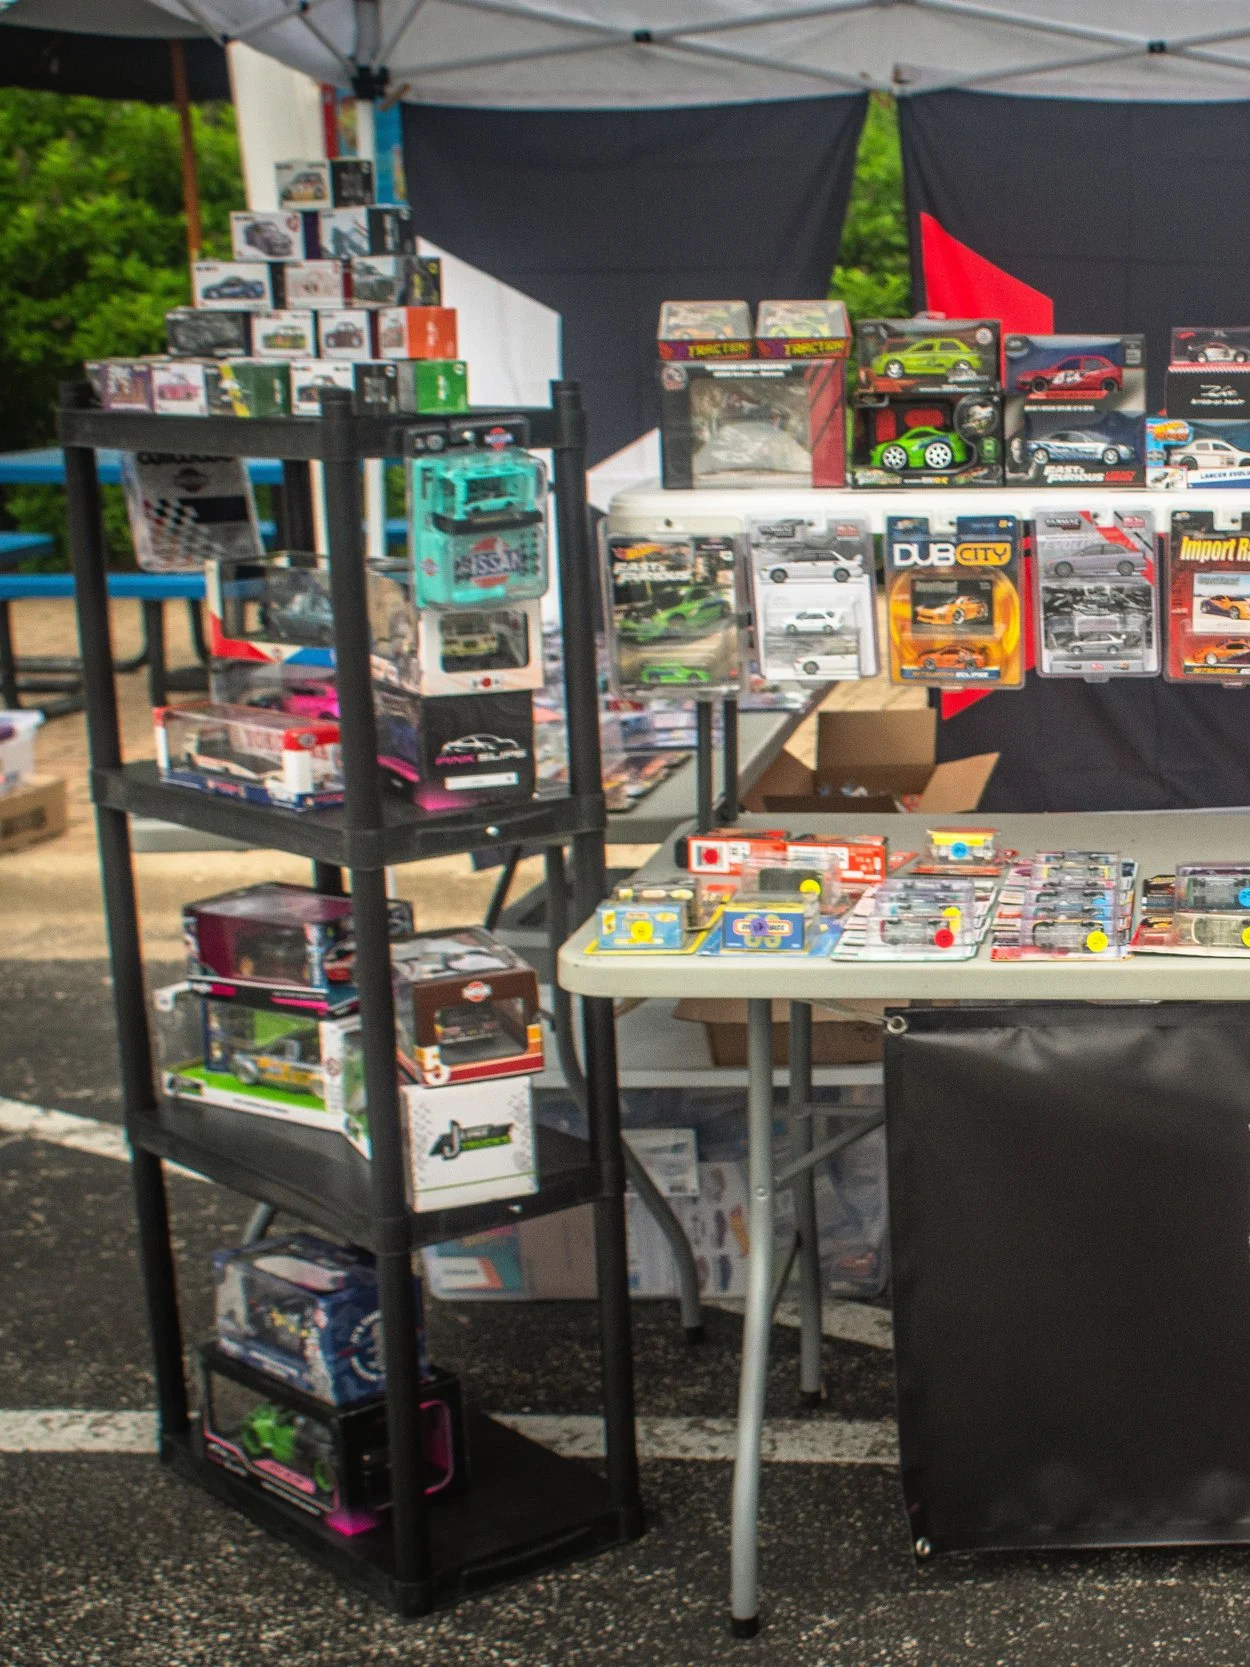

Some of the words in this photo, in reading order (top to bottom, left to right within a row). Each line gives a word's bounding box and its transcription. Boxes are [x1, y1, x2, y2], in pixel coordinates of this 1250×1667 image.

[892, 543, 956, 566] DUB
[959, 547, 1008, 561] CITY
[1179, 536, 1237, 563] Import
